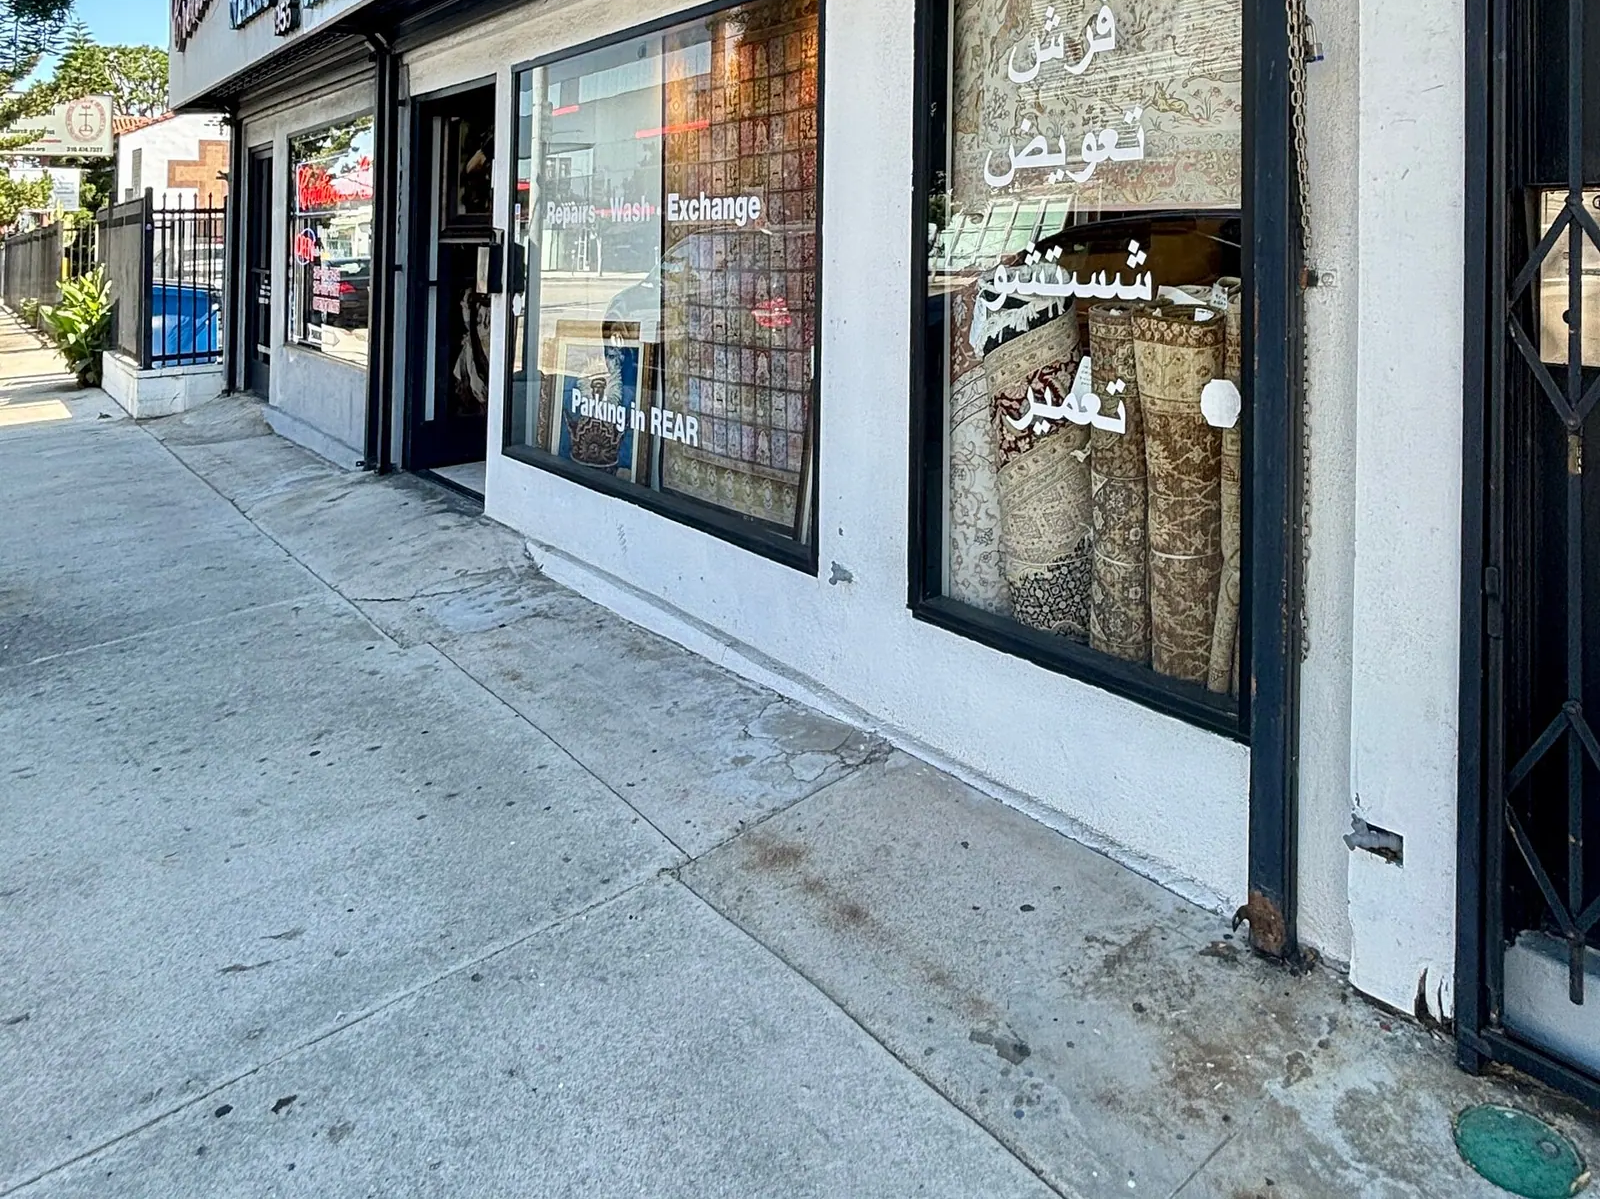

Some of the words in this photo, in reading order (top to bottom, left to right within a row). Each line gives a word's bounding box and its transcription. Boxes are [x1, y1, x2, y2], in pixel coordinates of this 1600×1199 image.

[547, 201, 596, 229] Repairs
[610, 194, 650, 223] Wash
[667, 192, 761, 227] Exchange
[986, 239, 1153, 312] شستشو
[572, 387, 627, 433] Parking
[630, 400, 646, 434] in
[650, 406, 700, 448] REAR
